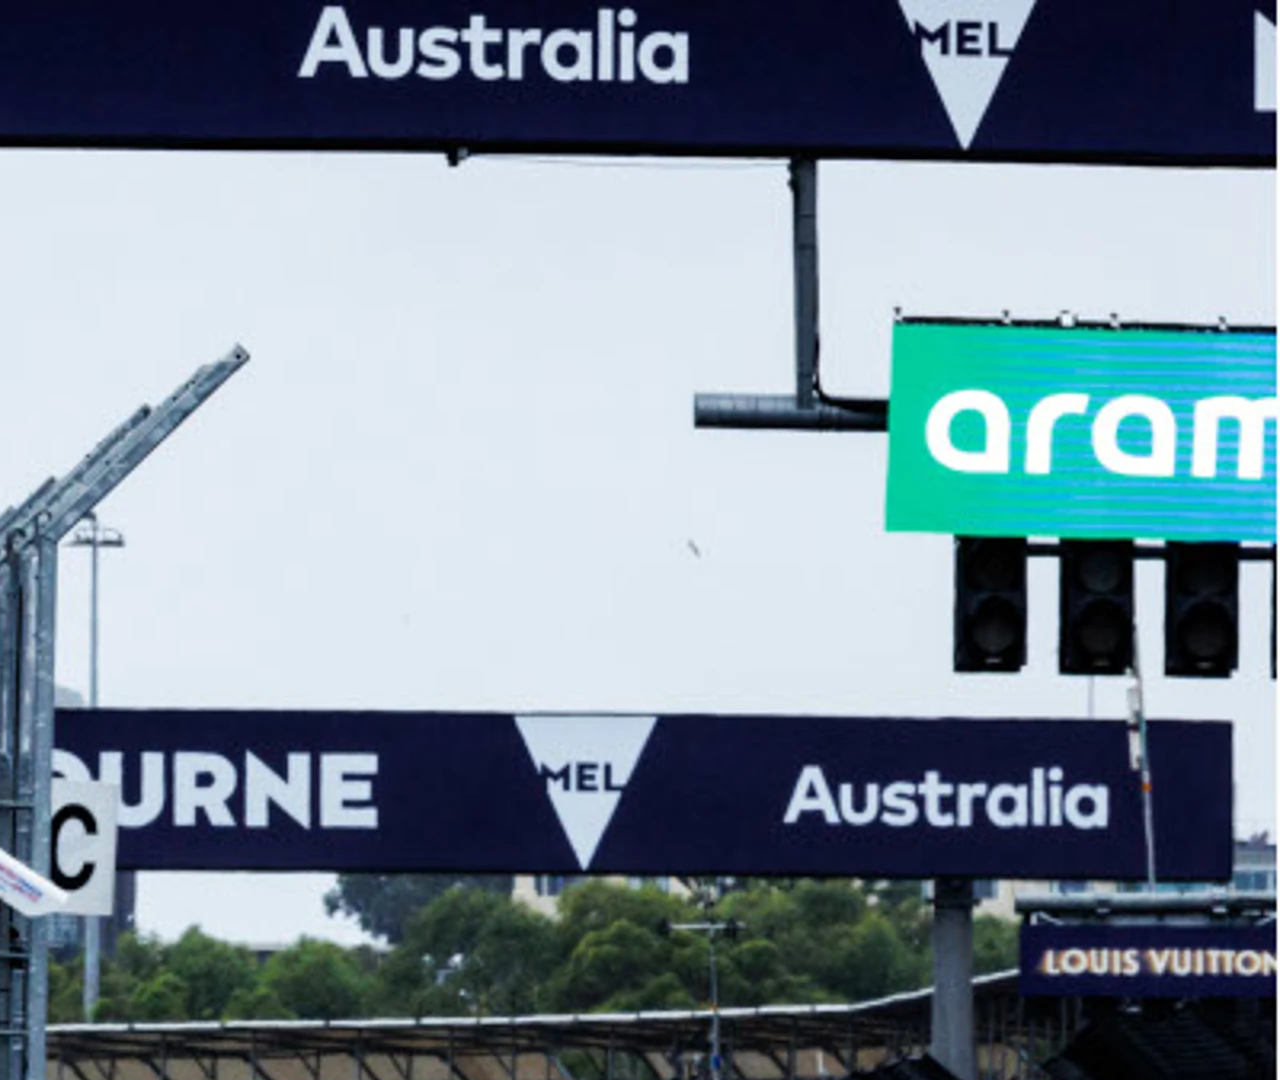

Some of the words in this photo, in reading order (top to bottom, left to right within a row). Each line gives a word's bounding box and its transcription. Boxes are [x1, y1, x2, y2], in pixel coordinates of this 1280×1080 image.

[297, 4, 690, 85] Australia
[913, 19, 1013, 58] MEL
[51, 748, 379, 831] URNE
[541, 761, 623, 793] MEL
[783, 764, 1110, 829] Australia
[1044, 948, 1141, 977] LOUIS
